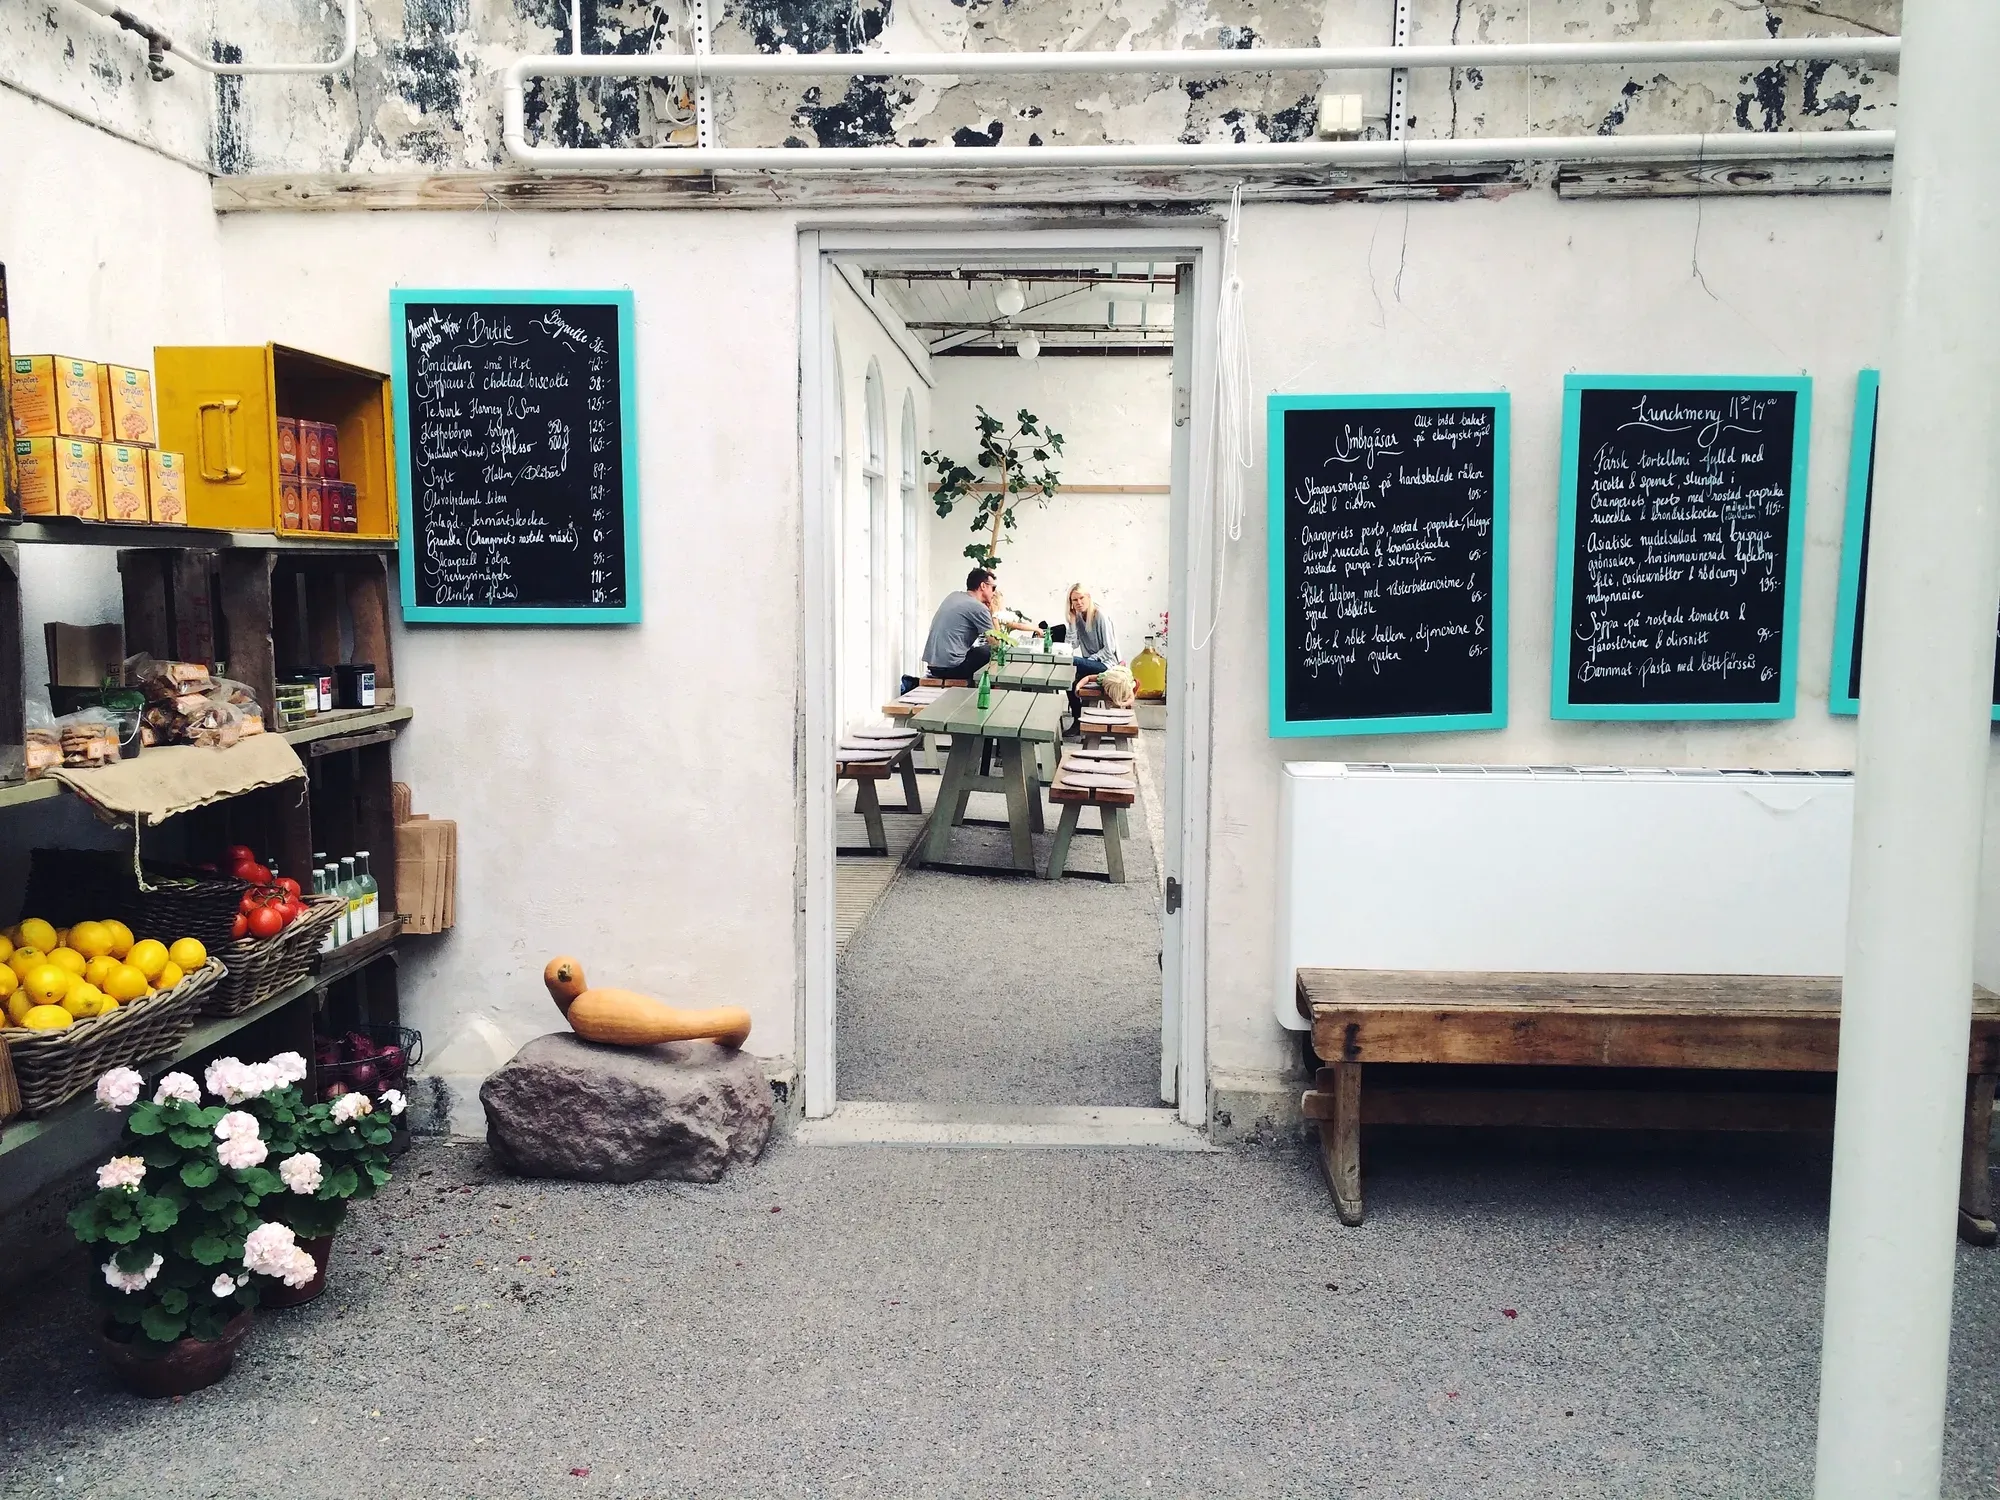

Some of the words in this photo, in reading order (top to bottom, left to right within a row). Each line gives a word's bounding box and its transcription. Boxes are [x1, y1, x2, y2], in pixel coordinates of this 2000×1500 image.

[467, 312, 514, 344] Butik
[544, 309, 588, 343] Baguette
[484, 355, 503, 370] små
[484, 371, 526, 390] choklad
[527, 371, 569, 389] biscotti
[418, 398, 462, 418] Teburk
[469, 397, 503, 431] Harney
[507, 395, 514, 416] &
[515, 397, 540, 420] Sons
[587, 396, 612, 411] 125:-
[588, 418, 614, 434] 125:-
[1414, 414, 1432, 428] Allt
[1438, 413, 1455, 426] bröd
[1459, 412, 1487, 426] bakat
[1631, 394, 1724, 447] Lunchmeny
[490, 441, 537, 464] espresso
[1335, 424, 1399, 470] Smörgåsar
[1413, 430, 1425, 447] på
[1432, 429, 1472, 449] ekologiskt
[1593, 442, 1629, 475] Färsk
[1637, 448, 1690, 469] tortelloni
[1699, 446, 1737, 476] fylld
[1741, 443, 1764, 463] med
[423, 466, 456, 490] Sylt
[482, 464, 512, 483] Hallon
[1295, 472, 1370, 506] Skagensmörgås
[1379, 472, 1392, 497] på
[1399, 465, 1453, 485] handskalade
[1458, 462, 1484, 479] räkor
[1591, 475, 1624, 491] ricotta
[1629, 471, 1636, 489] &
[1683, 471, 1724, 497] slungad
[1731, 470, 1735, 483] i
[485, 490, 507, 505] liten
[1308, 497, 1327, 514] dill
[1345, 496, 1376, 510] citron
[1590, 492, 1645, 514] Orangeriets
[1652, 493, 1680, 513] pesto
[1687, 488, 1705, 503] med
[1711, 485, 1741, 501] rostad
[1745, 482, 1784, 508] paprika
[1590, 509, 1632, 524] ruccola
[1302, 525, 1353, 550] Orangeriets
[1392, 518, 1418, 533] rostad
[1587, 532, 1633, 553] Asiatisk
[1640, 527, 1697, 546] nudelsallad
[1703, 526, 1723, 543] med
[1730, 519, 1773, 552] krispiga
[485, 553, 490, 565] i
[491, 550, 511, 574] olja
[1332, 542, 1369, 558] ruccola
[1375, 539, 1383, 557] &
[1644, 544, 1727, 565] hoisinmarinerad
[1304, 556, 1337, 575] rostade
[1345, 561, 1375, 578] pumpa-
[1388, 551, 1436, 571] solrosfrön
[1622, 566, 1684, 586] cashewnötter
[1300, 581, 1324, 609] Rökt
[1364, 580, 1381, 598] med
[1586, 587, 1644, 616] mayonnaise
[1305, 605, 1328, 631] syrad
[1332, 630, 1340, 648] &
[1345, 628, 1366, 645] rökt
[1475, 615, 1485, 635] &
[1575, 611, 1619, 641] Soppa
[1624, 611, 1641, 635] på
[1645, 606, 1684, 626] rostade
[1688, 606, 1729, 622] tomater
[1738, 602, 1746, 621] &
[1655, 629, 1664, 650] &
[1666, 630, 1710, 646] olivsnitt
[1303, 647, 1355, 678] mjölksyrad
[1367, 645, 1402, 675] gurka
[1578, 661, 1633, 683] Barnmat
[1638, 657, 1671, 688] Pasta
[1677, 656, 1694, 672] med
[1698, 650, 1756, 680] köttfärssås
